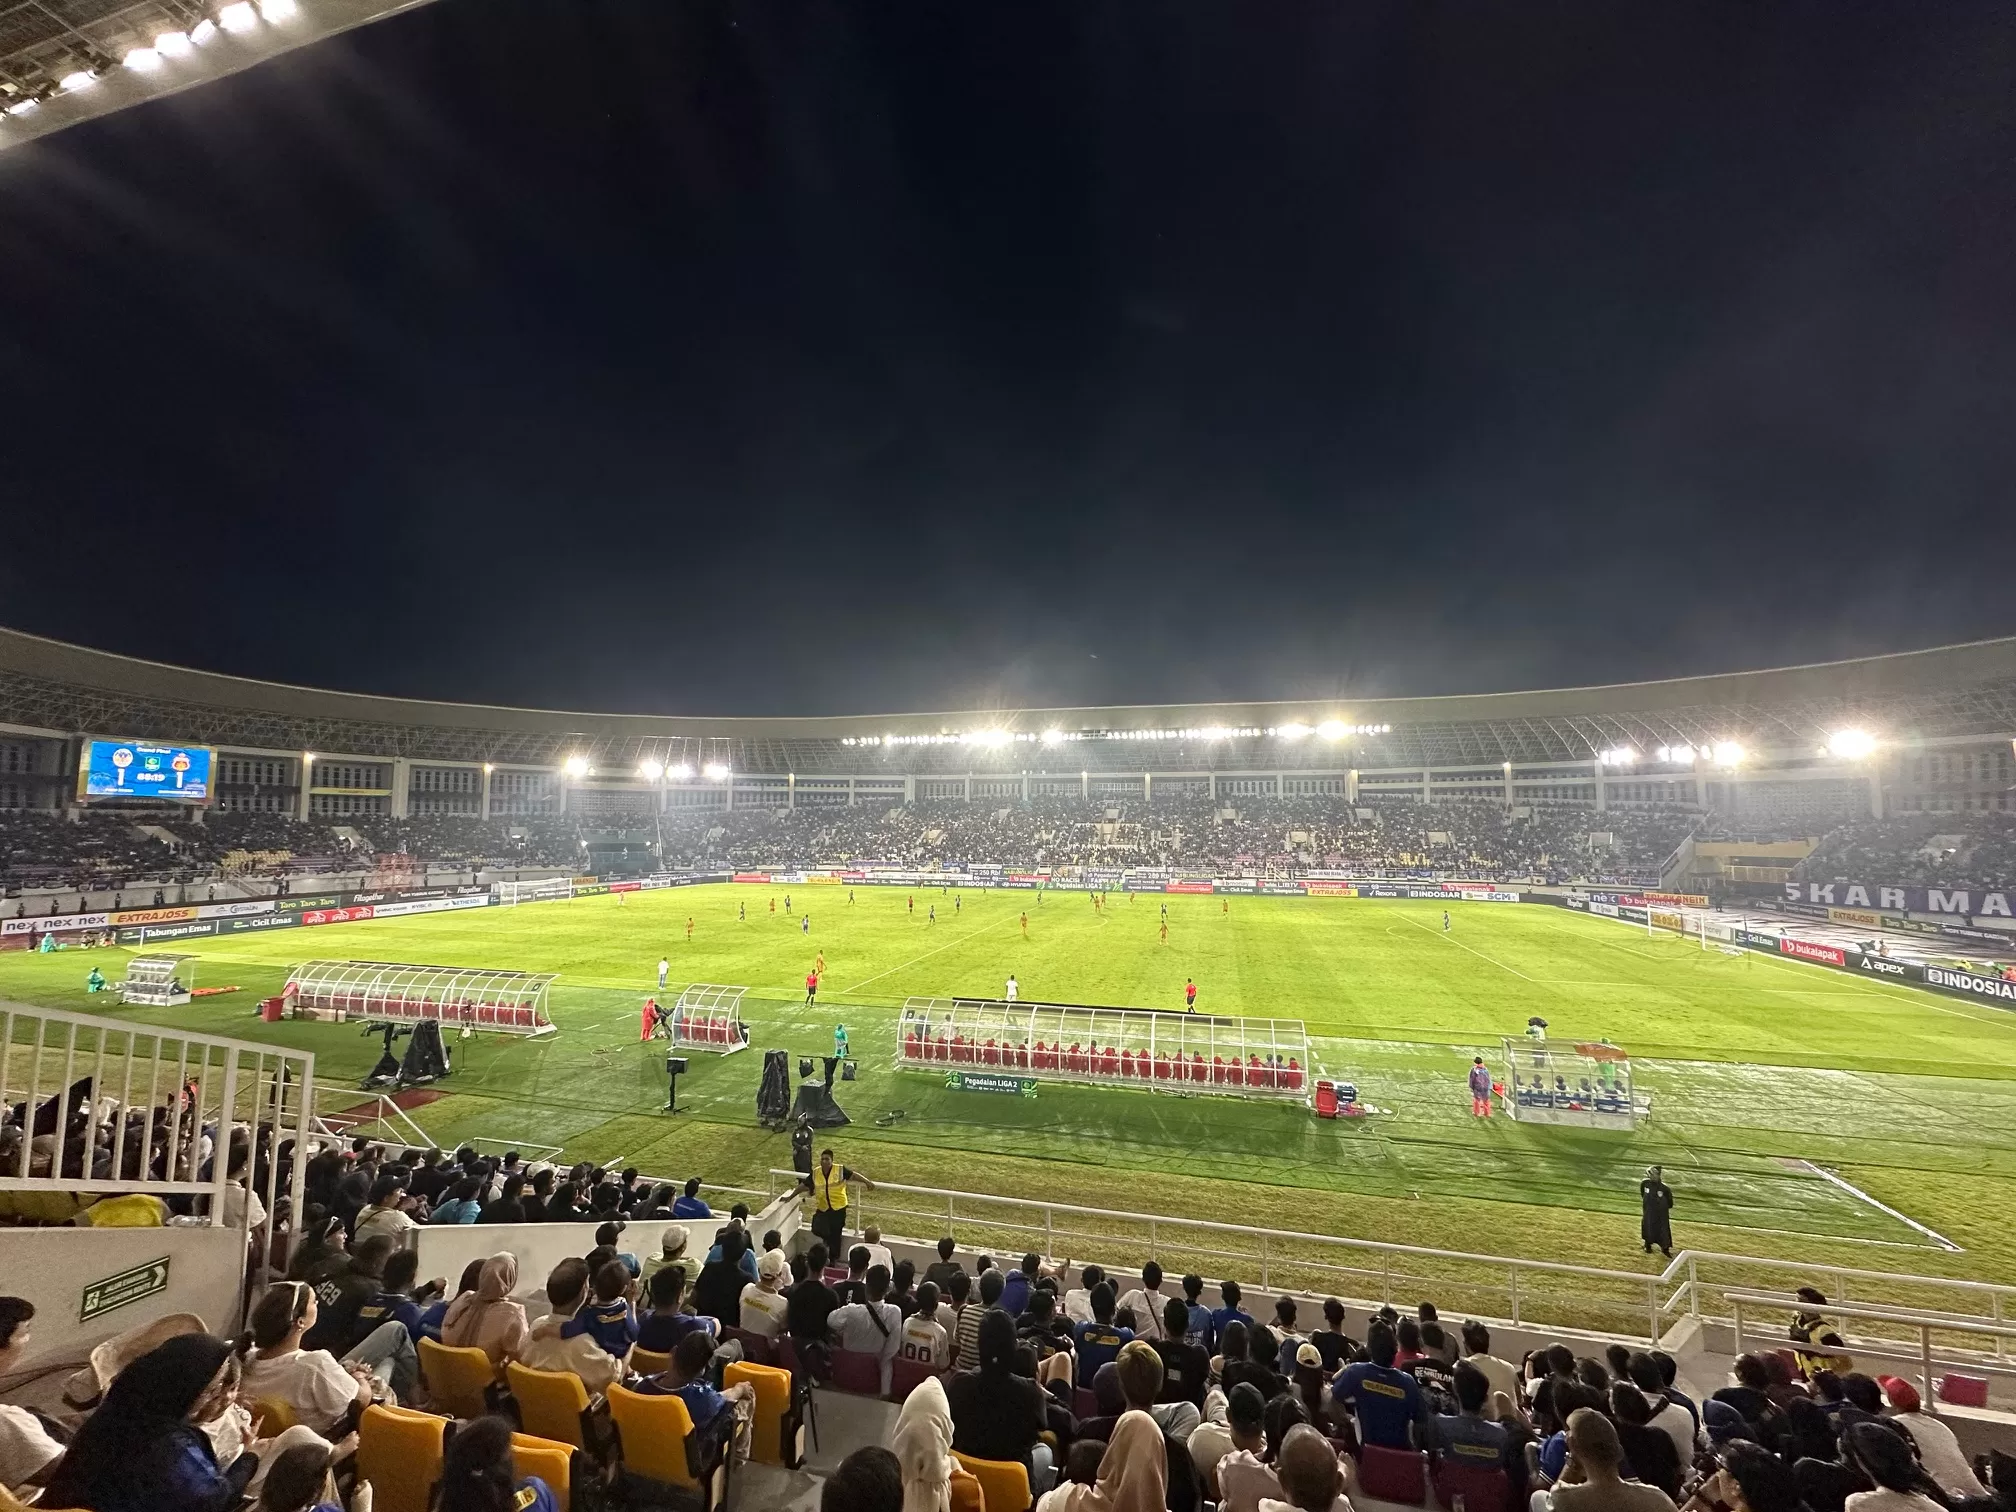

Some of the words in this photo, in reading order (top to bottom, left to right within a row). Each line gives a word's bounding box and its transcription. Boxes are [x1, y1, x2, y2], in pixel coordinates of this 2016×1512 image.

[117, 768, 125, 787] 1
[176, 771, 184, 789] 1
[1418, 890, 1461, 899] INDOSIAR
[1487, 892, 1511, 901] SCM
[279, 901, 296, 909] Taro
[300, 900, 316, 908] Taro
[319, 898, 336, 906] Taro
[6, 920, 37, 932] nex
[43, 918, 73, 929] nex
[78, 915, 106, 926] nex
[252, 918, 270, 927] Cicil
[270, 917, 292, 926] Emas
[144, 926, 188, 938] Tabungan
[188, 924, 212, 933] Emas
[1748, 934, 1759, 943] Cicil
[1759, 936, 1774, 946] Emas
[1796, 943, 1838, 961] bukalapak
[1873, 961, 1905, 975] apex
[1944, 971, 2016, 1000] INDOSIA
[964, 1076, 997, 1086] Pegadaian
[997, 1079, 1013, 1088] LIGA
